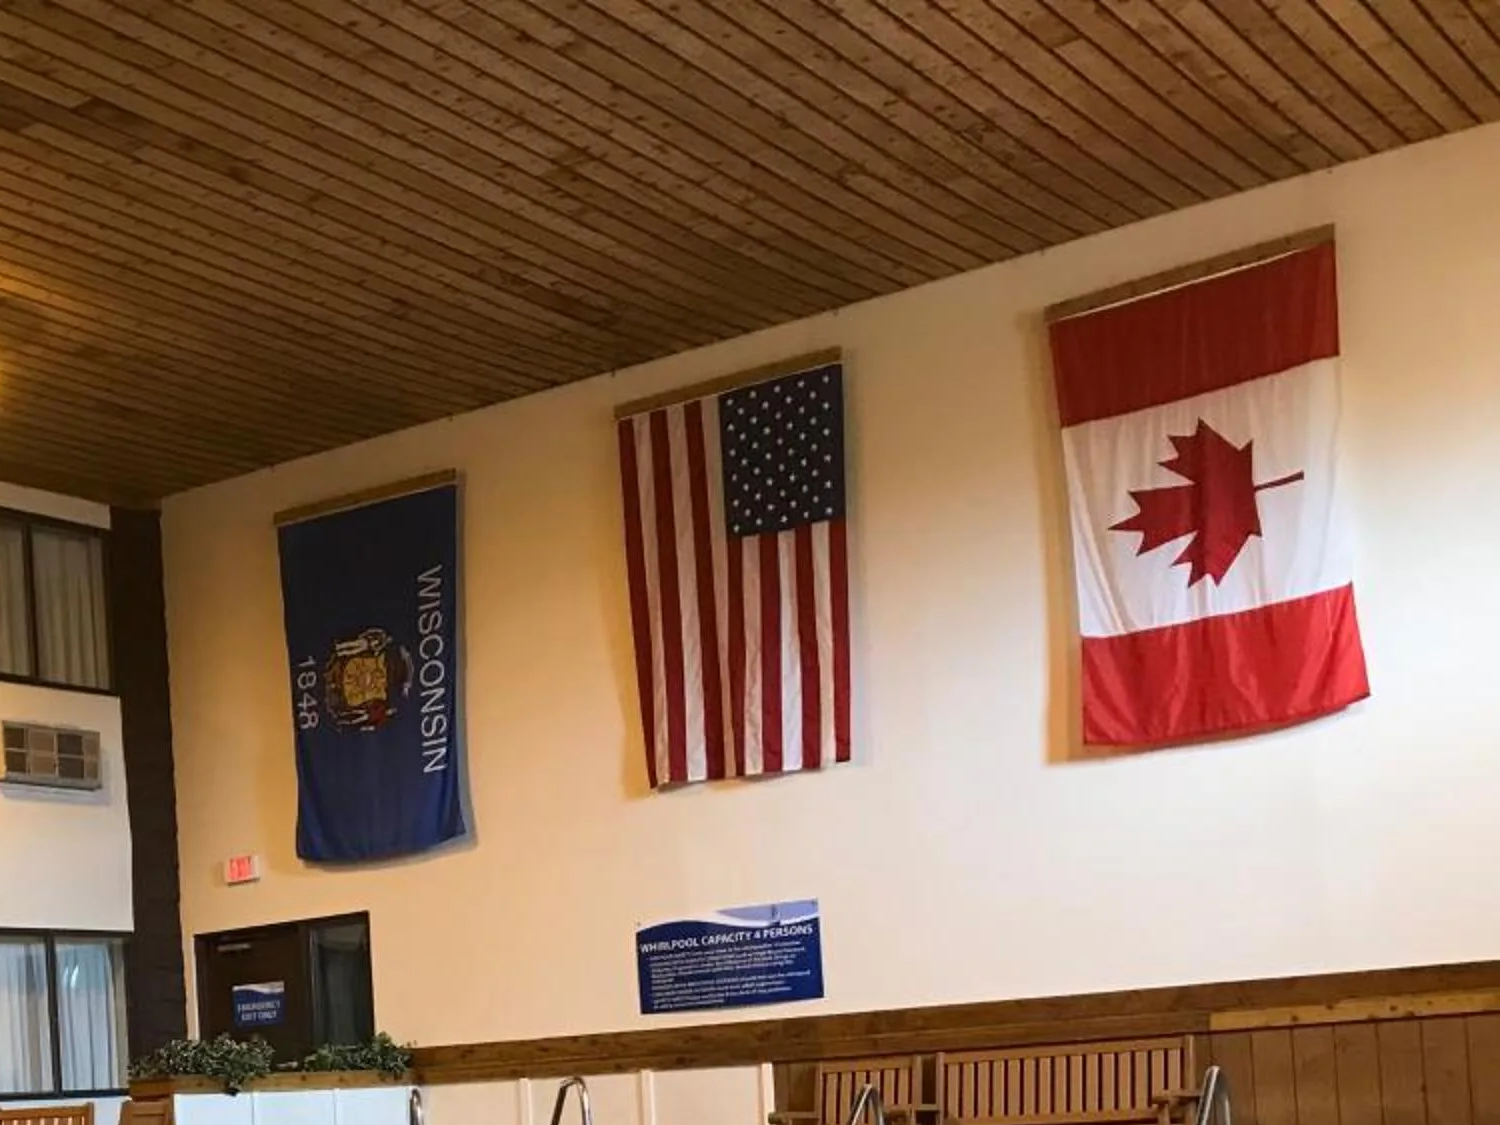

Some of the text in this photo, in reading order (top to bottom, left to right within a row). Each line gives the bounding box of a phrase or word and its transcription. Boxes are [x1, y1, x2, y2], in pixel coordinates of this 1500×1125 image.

[297, 655, 319, 730] 1848
[417, 564, 448, 774] WISCONSIN
[641, 923, 814, 953] WHIRLPOOL CAPACITY 4 PERSONS
